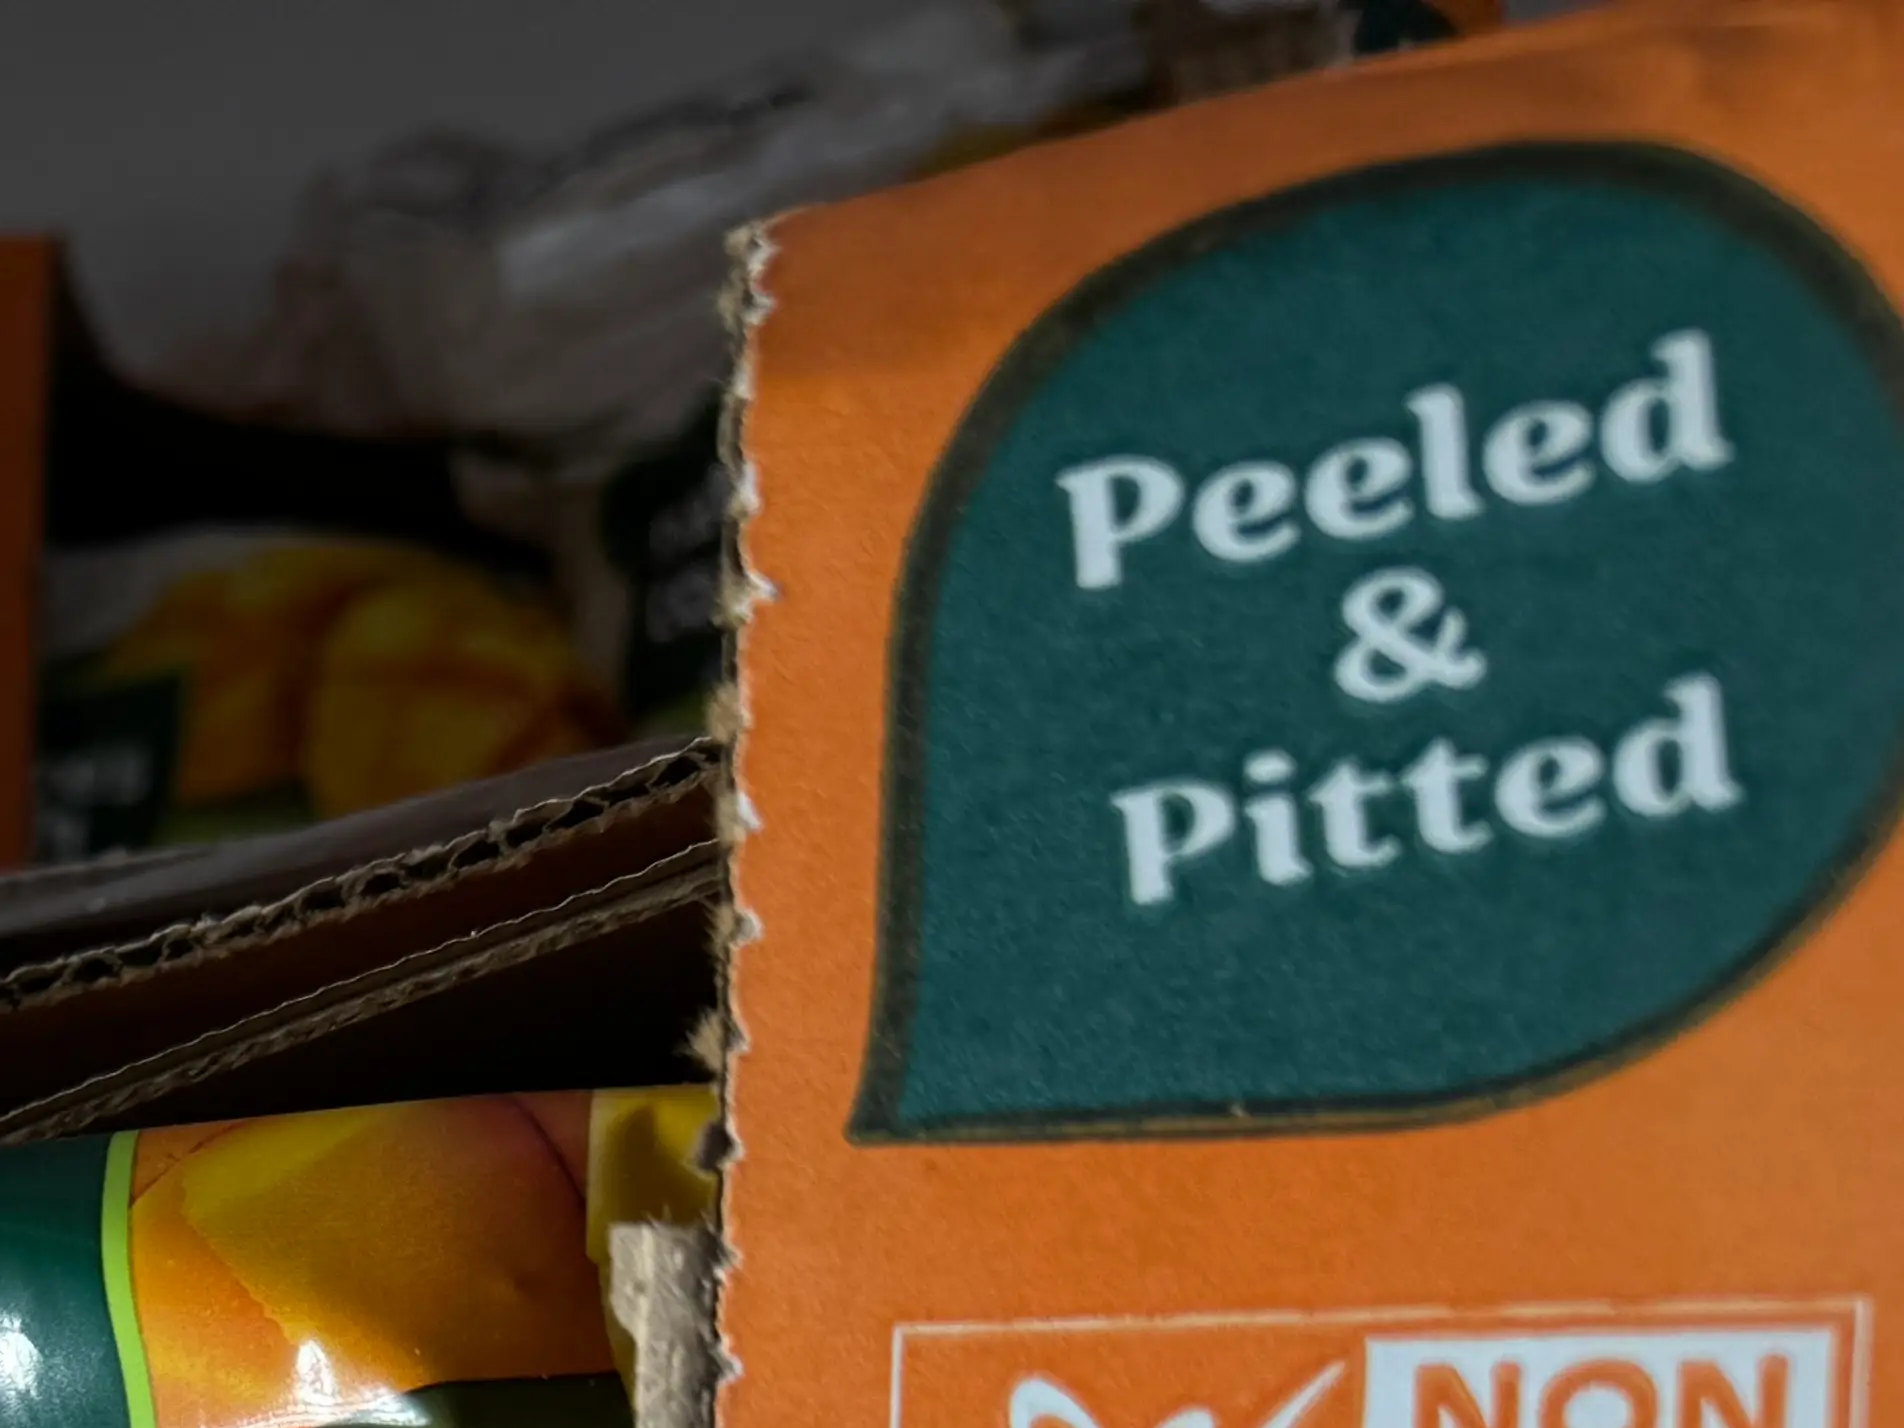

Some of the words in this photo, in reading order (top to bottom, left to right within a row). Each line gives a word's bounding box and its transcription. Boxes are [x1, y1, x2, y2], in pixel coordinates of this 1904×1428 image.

[1056, 329, 1734, 588] Peeled
[1332, 567, 1485, 701] &
[1112, 672, 1742, 903] Pitted
